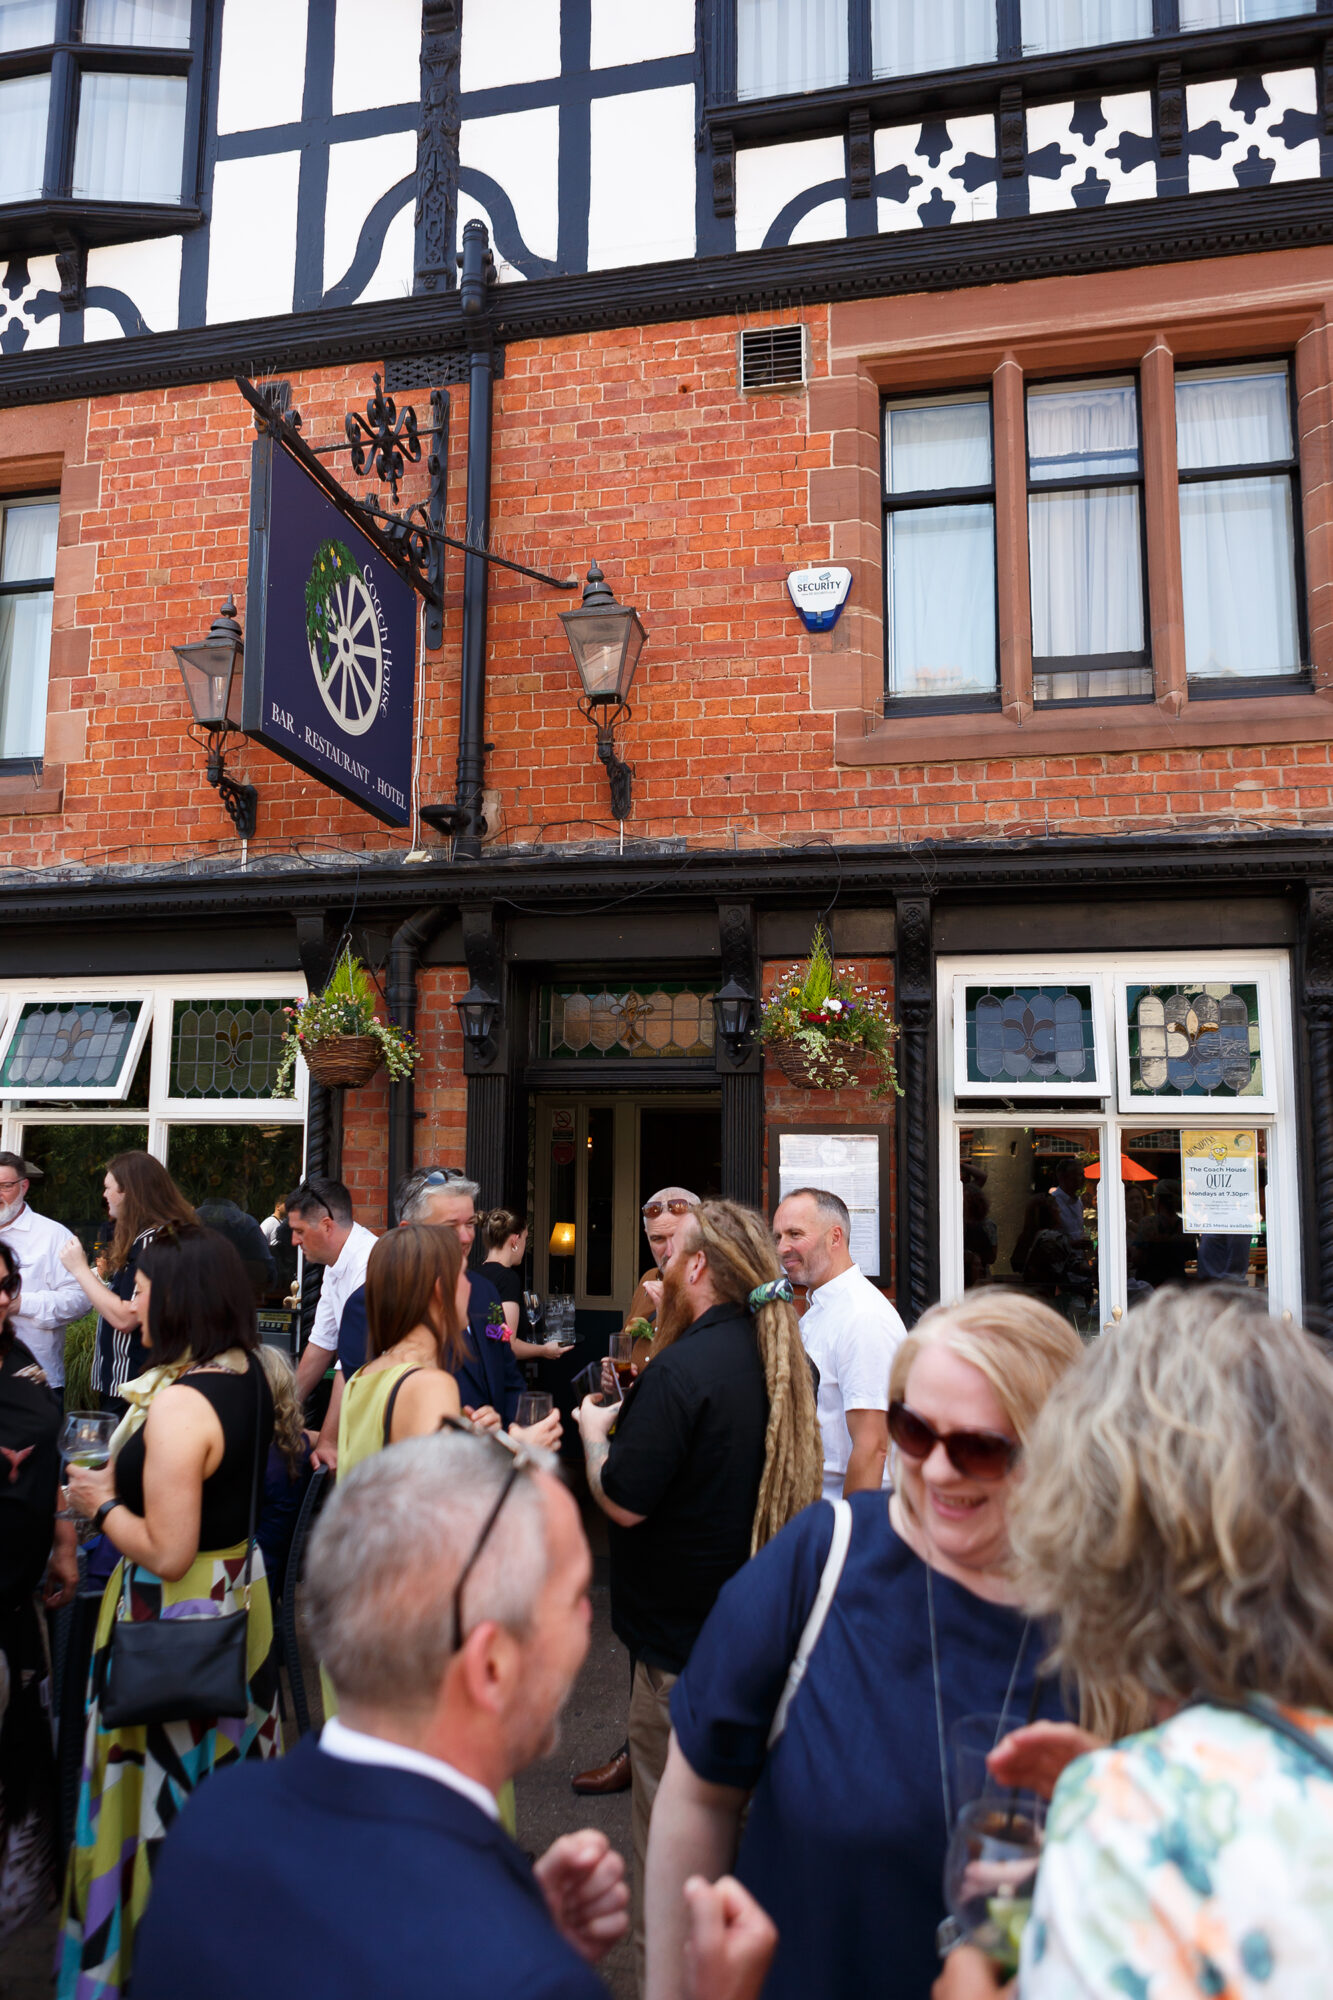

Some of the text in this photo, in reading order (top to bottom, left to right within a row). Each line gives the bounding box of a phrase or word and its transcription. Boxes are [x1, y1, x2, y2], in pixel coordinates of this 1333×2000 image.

[797, 581, 841, 592] SECURITY
[363, 564, 391, 718] Coach House
[271, 702, 407, 811] BAR RESTAURANT HOTEL
[1206, 1174, 1232, 1189] QUIZ
